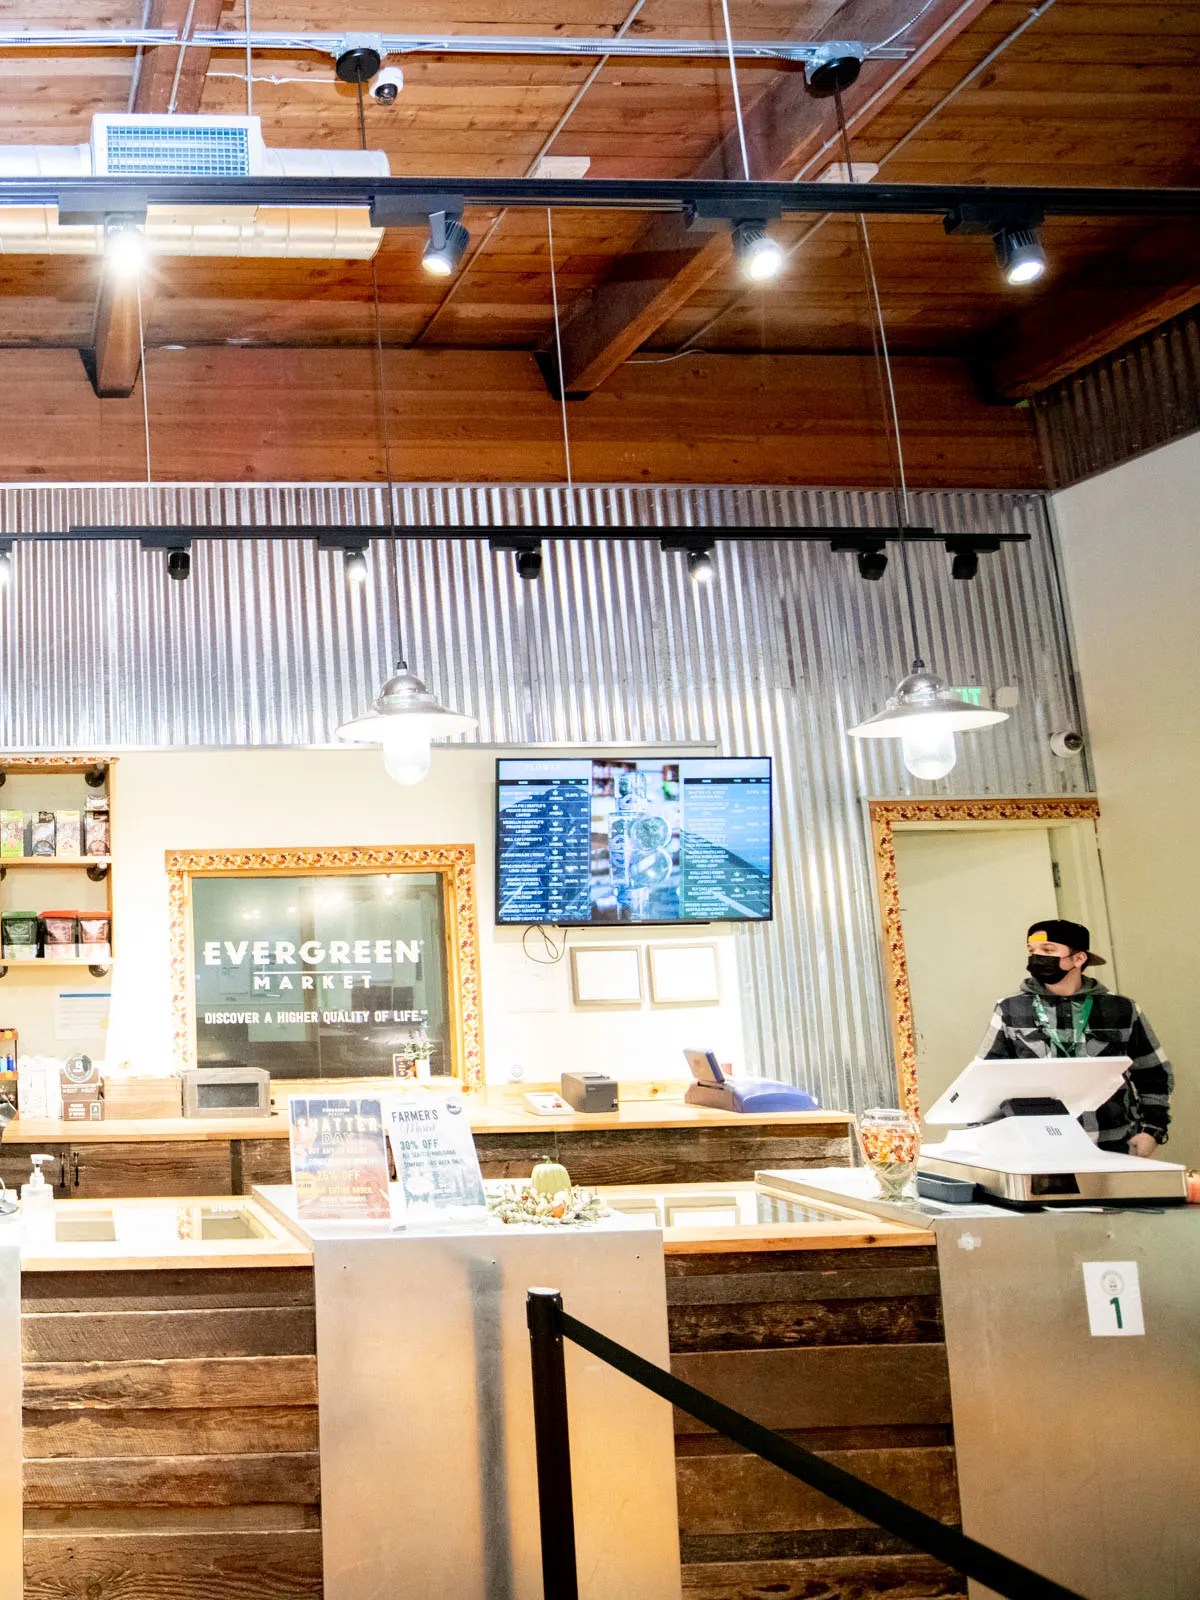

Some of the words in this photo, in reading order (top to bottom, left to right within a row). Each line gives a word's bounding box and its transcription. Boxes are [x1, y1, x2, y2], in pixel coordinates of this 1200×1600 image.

[203, 940, 421, 965] EVERGREEN
[254, 975, 372, 990] MARKET
[204, 1012, 259, 1024] DISCOVER
[264, 1012, 272, 1023] A
[277, 1011, 319, 1024] HIGHER
[323, 1010, 370, 1024] QUALITY
[374, 1010, 389, 1022] OF
[391, 1109, 439, 1123] FARMER'S
[321, 1132, 354, 1145] DAY
[400, 1140, 418, 1151] 30%
[422, 1139, 439, 1149] OFF
[343, 1169, 361, 1181] OFF
[1109, 1297, 1123, 1329] 1
